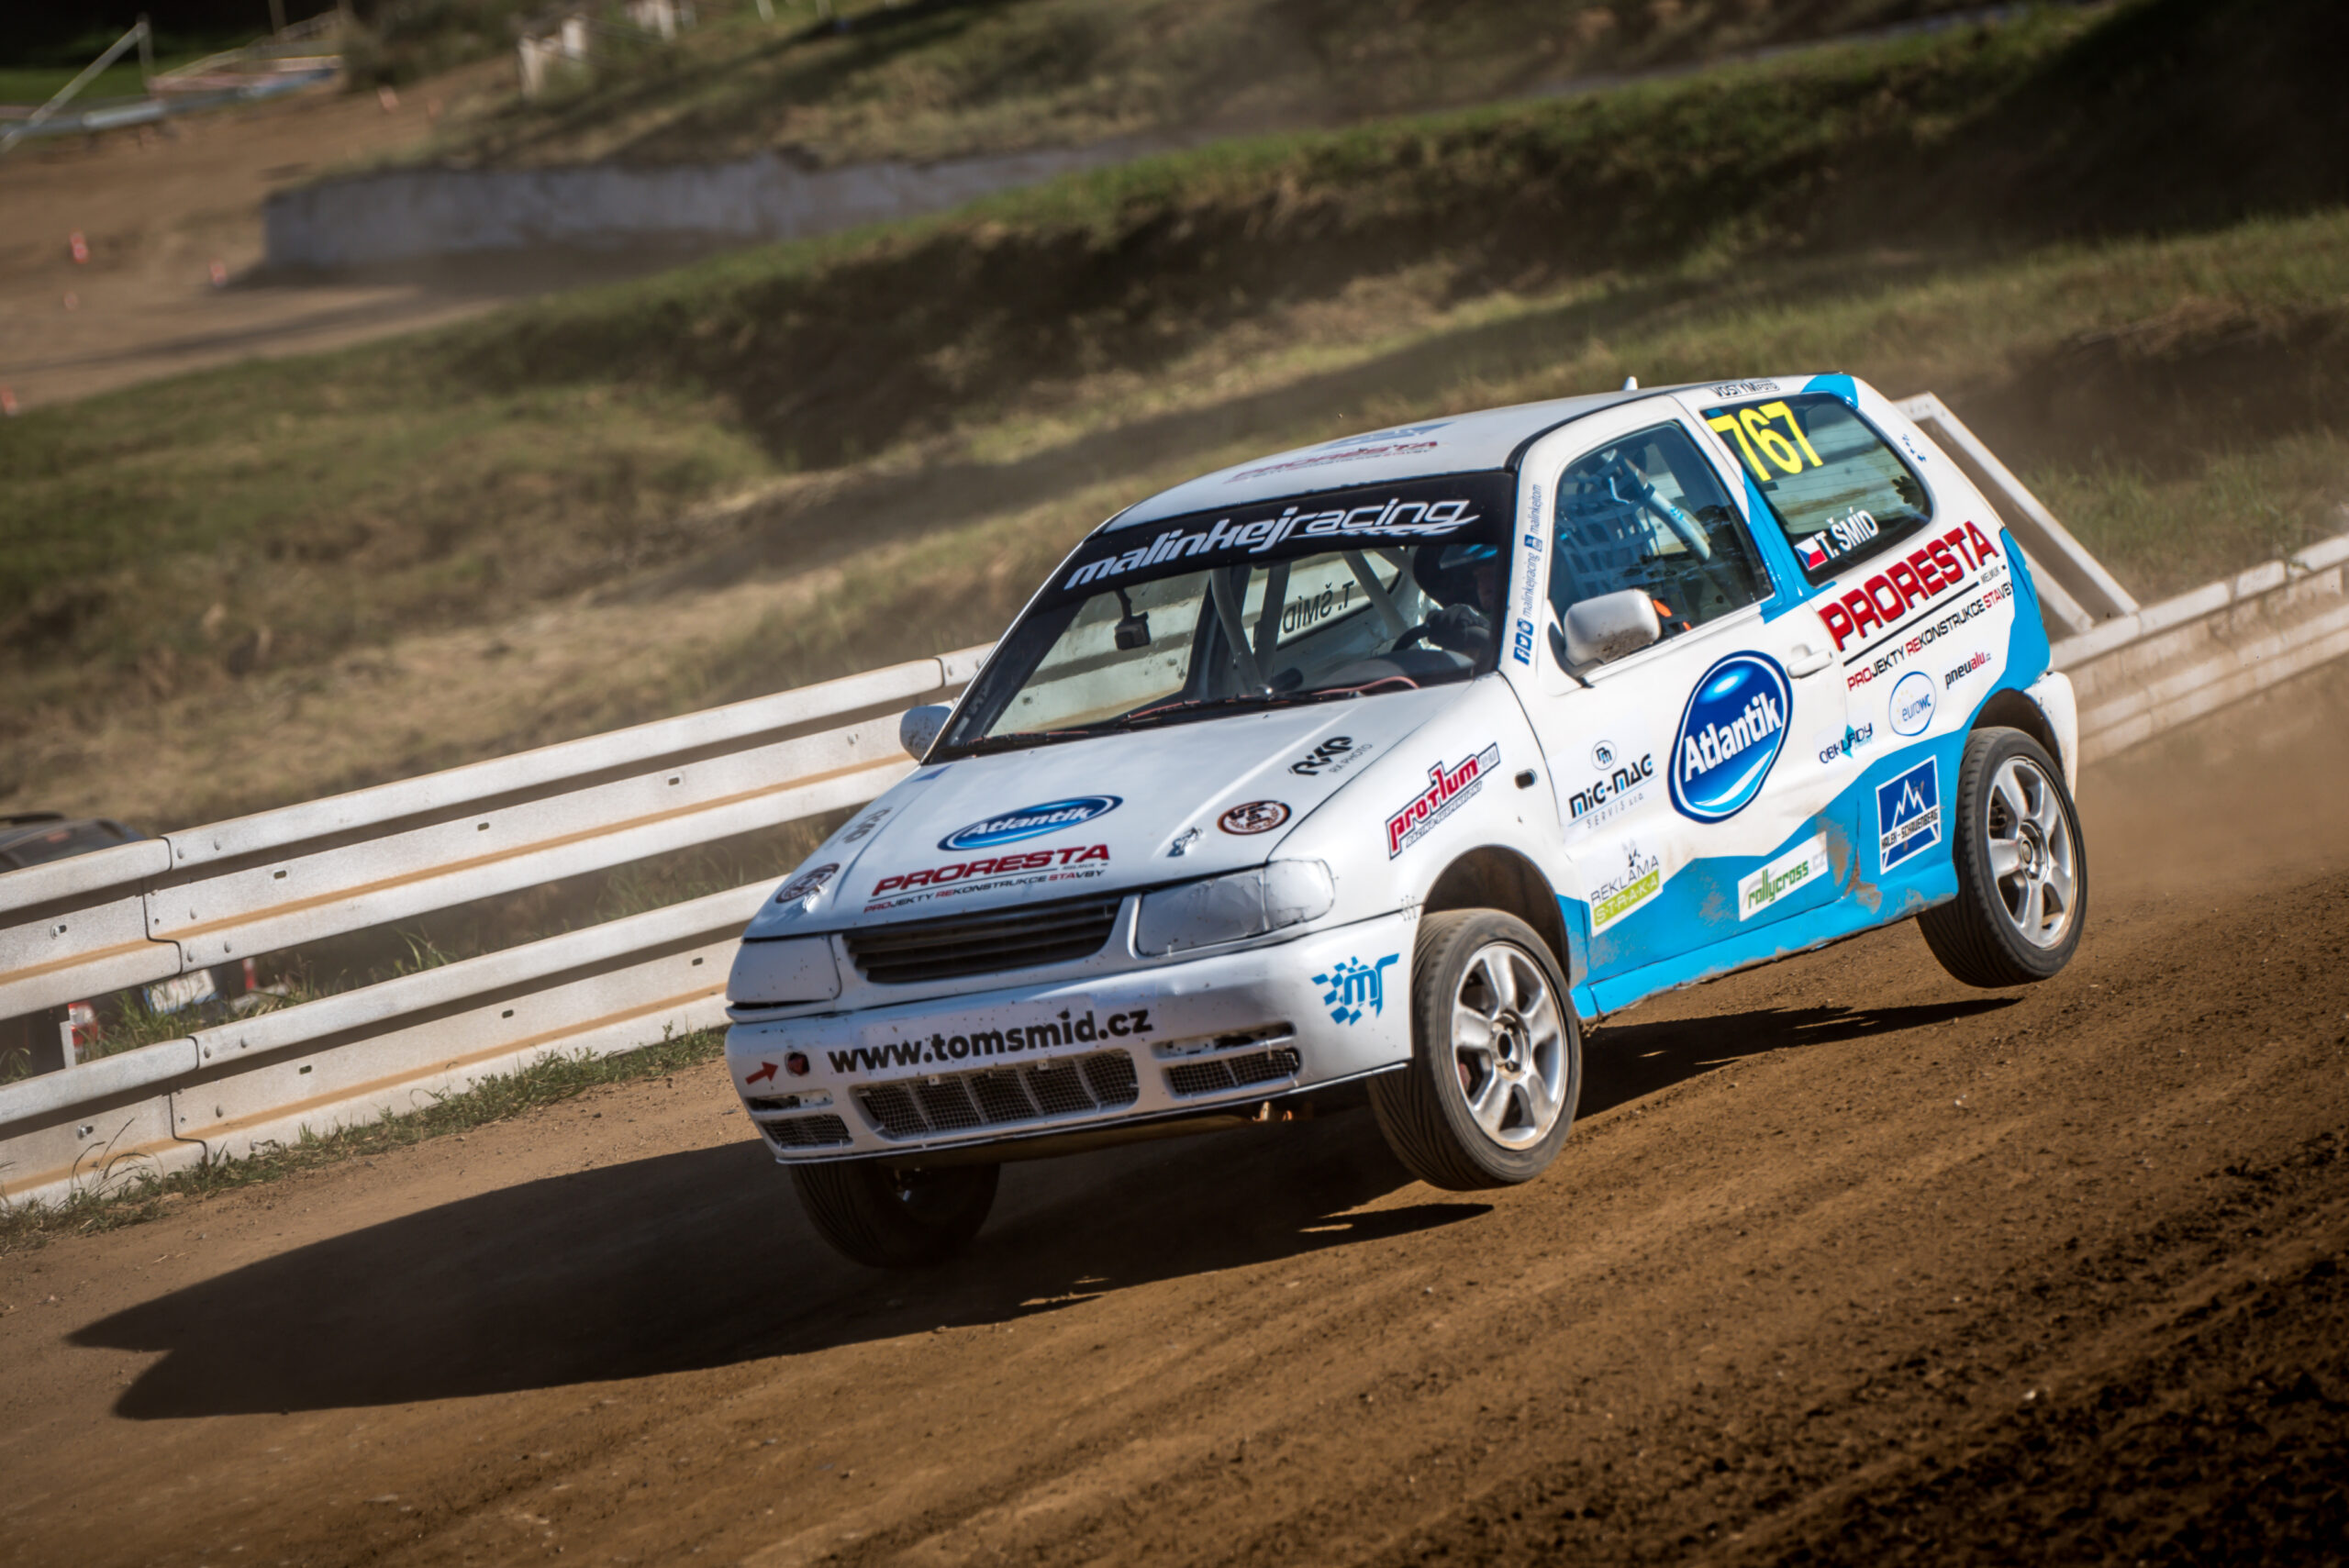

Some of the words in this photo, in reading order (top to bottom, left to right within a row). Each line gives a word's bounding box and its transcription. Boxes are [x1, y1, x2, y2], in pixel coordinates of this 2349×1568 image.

[1707, 401, 1823, 483] 767
[1063, 497, 1480, 592] malinkejracing
[1814, 529, 1840, 561] T.
[1827, 506, 1880, 553] ŠMÍD
[1817, 520, 2000, 652] PRORESTA
[1846, 645, 1905, 692] PROJEKTY
[1905, 598, 1987, 657] REKONSTRUKCE
[1982, 580, 2015, 609] STAVBY
[1684, 691, 1783, 784] Atlantik
[962, 806, 1097, 838] Atlantik
[863, 893, 934, 914] PROJEKTY
[934, 874, 1047, 899] REKONSTRUKCE
[1048, 870, 1106, 882] STAVBY
[872, 843, 1110, 897] PRORESTA
[1590, 855, 1659, 906] REKLAMA
[828, 1008, 1154, 1073] www.tomsmid.cz
